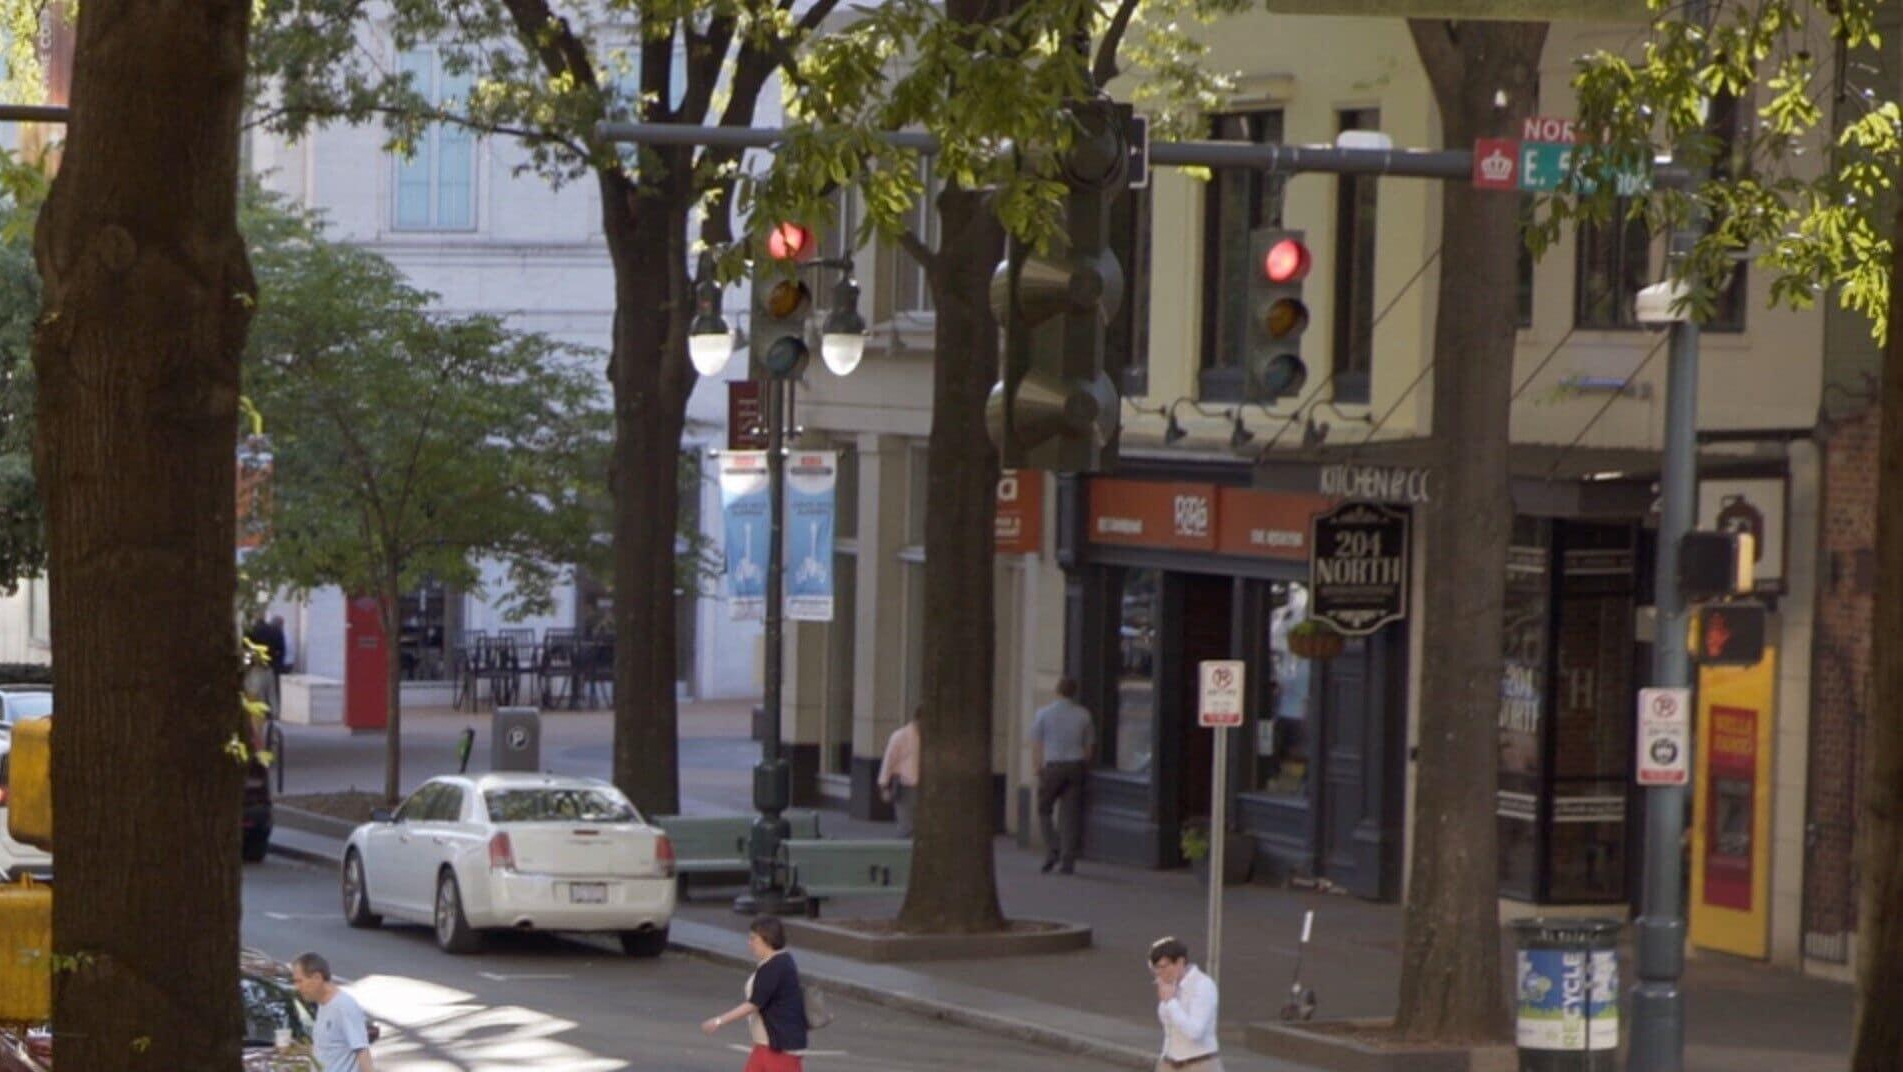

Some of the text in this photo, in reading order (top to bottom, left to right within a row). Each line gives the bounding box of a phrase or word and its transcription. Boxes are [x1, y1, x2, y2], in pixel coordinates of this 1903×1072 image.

[1321, 465, 1387, 498] KITCHEN
[1335, 531, 1382, 558] 204
[1316, 556, 1400, 585] NORTH
